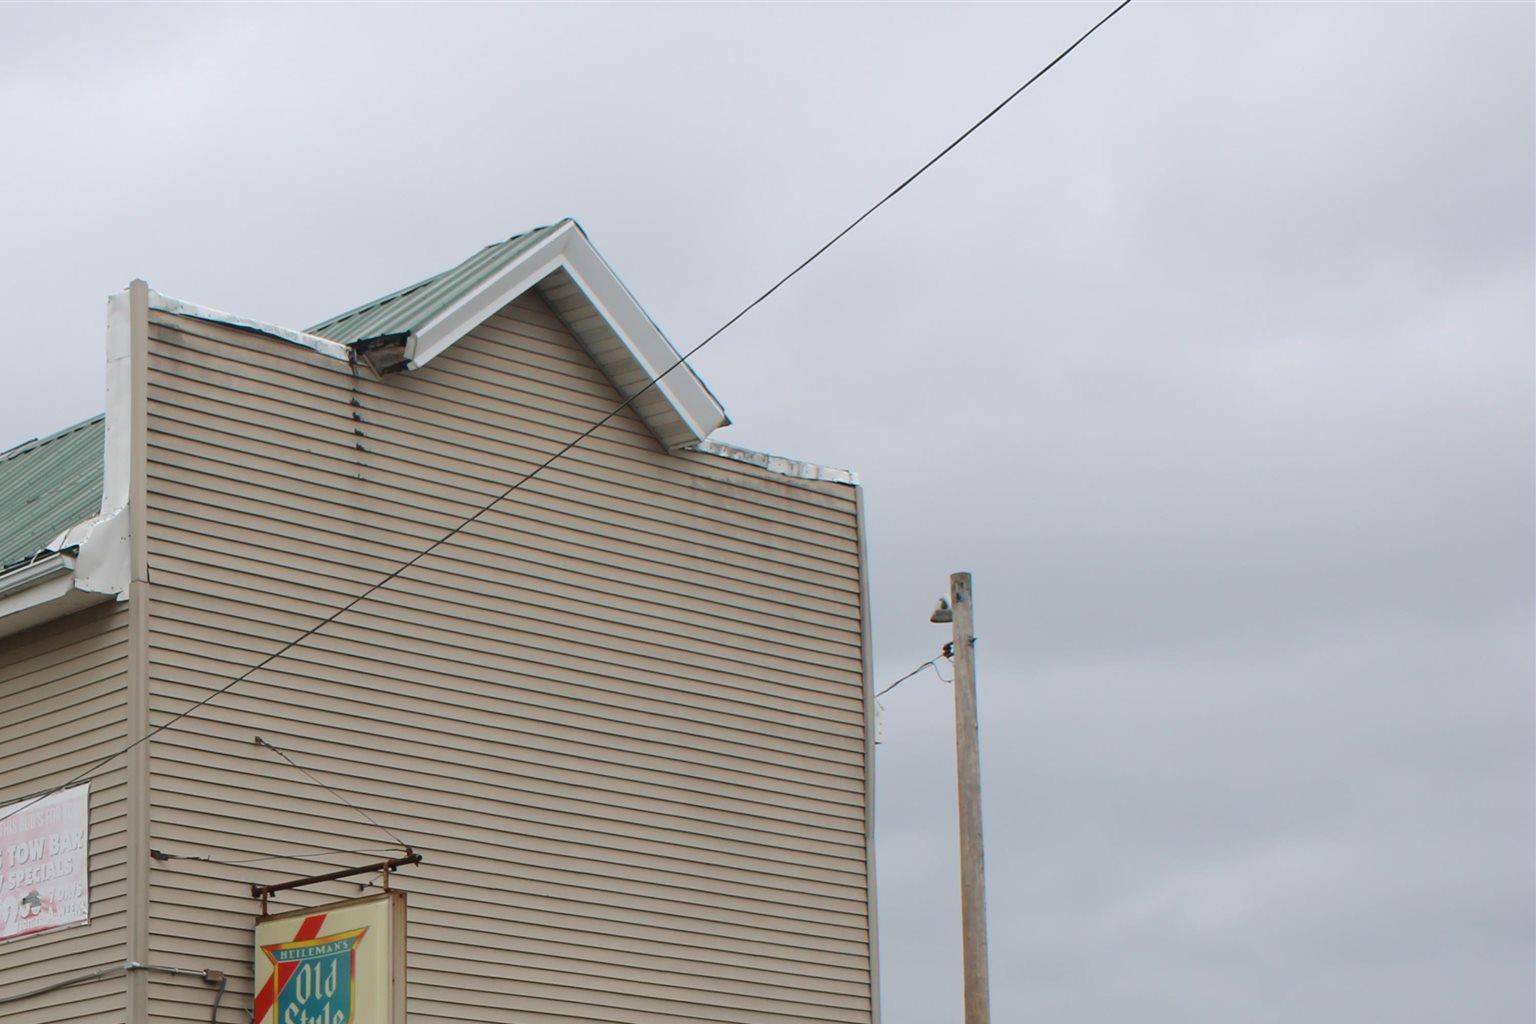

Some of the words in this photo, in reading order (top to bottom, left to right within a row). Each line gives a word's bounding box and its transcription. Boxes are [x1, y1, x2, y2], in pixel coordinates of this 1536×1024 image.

[9, 836, 46, 868] TOW
[50, 829, 85, 857] BAR
[8, 857, 73, 891] SPECIALS
[280, 941, 348, 960] HEILEMAN'S
[295, 957, 339, 1005] Old
